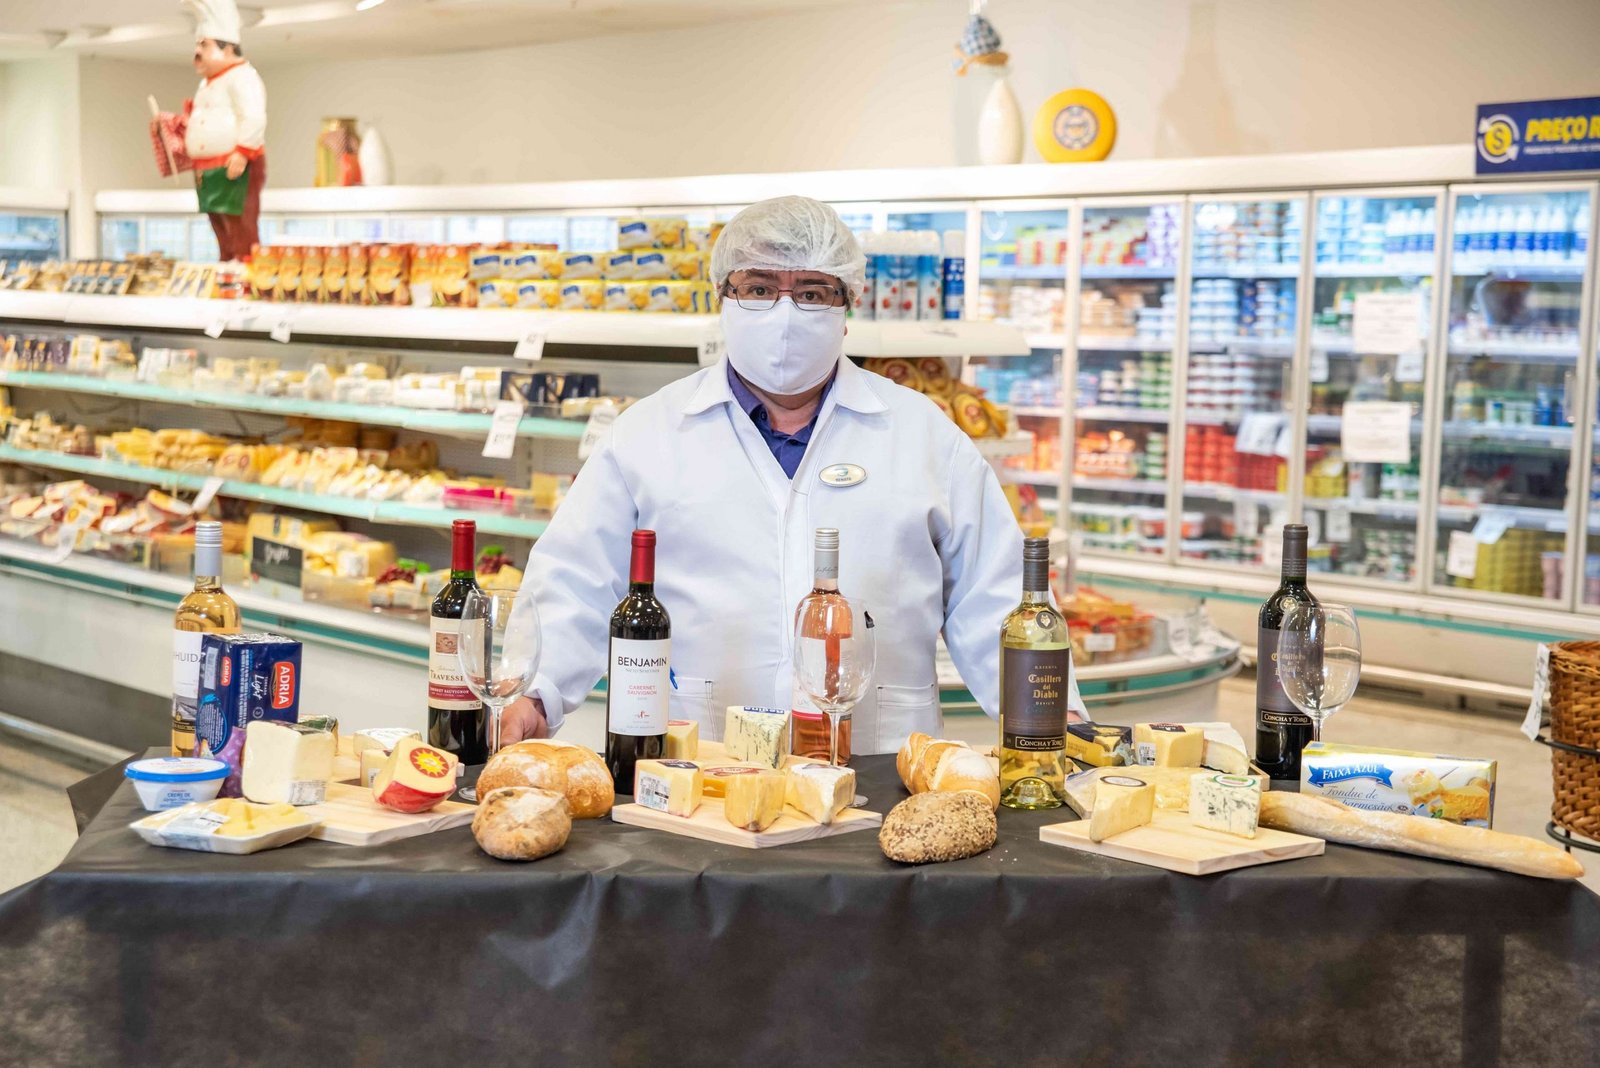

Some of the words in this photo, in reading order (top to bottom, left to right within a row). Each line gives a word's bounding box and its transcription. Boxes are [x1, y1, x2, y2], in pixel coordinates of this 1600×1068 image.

[1524, 115, 1588, 143] PREÇO
[617, 656, 668, 668] BENJAMIN
[222, 658, 230, 684] ADRIA
[1028, 673, 1062, 684] Casillero
[250, 674, 265, 700] Light
[278, 665, 291, 705] ADRIA
[1032, 689, 1059, 699] Diablo
[1019, 739, 1046, 747] CONCHA
[1322, 765, 1351, 780] FAIXA
[1353, 763, 1379, 775] AZUL
